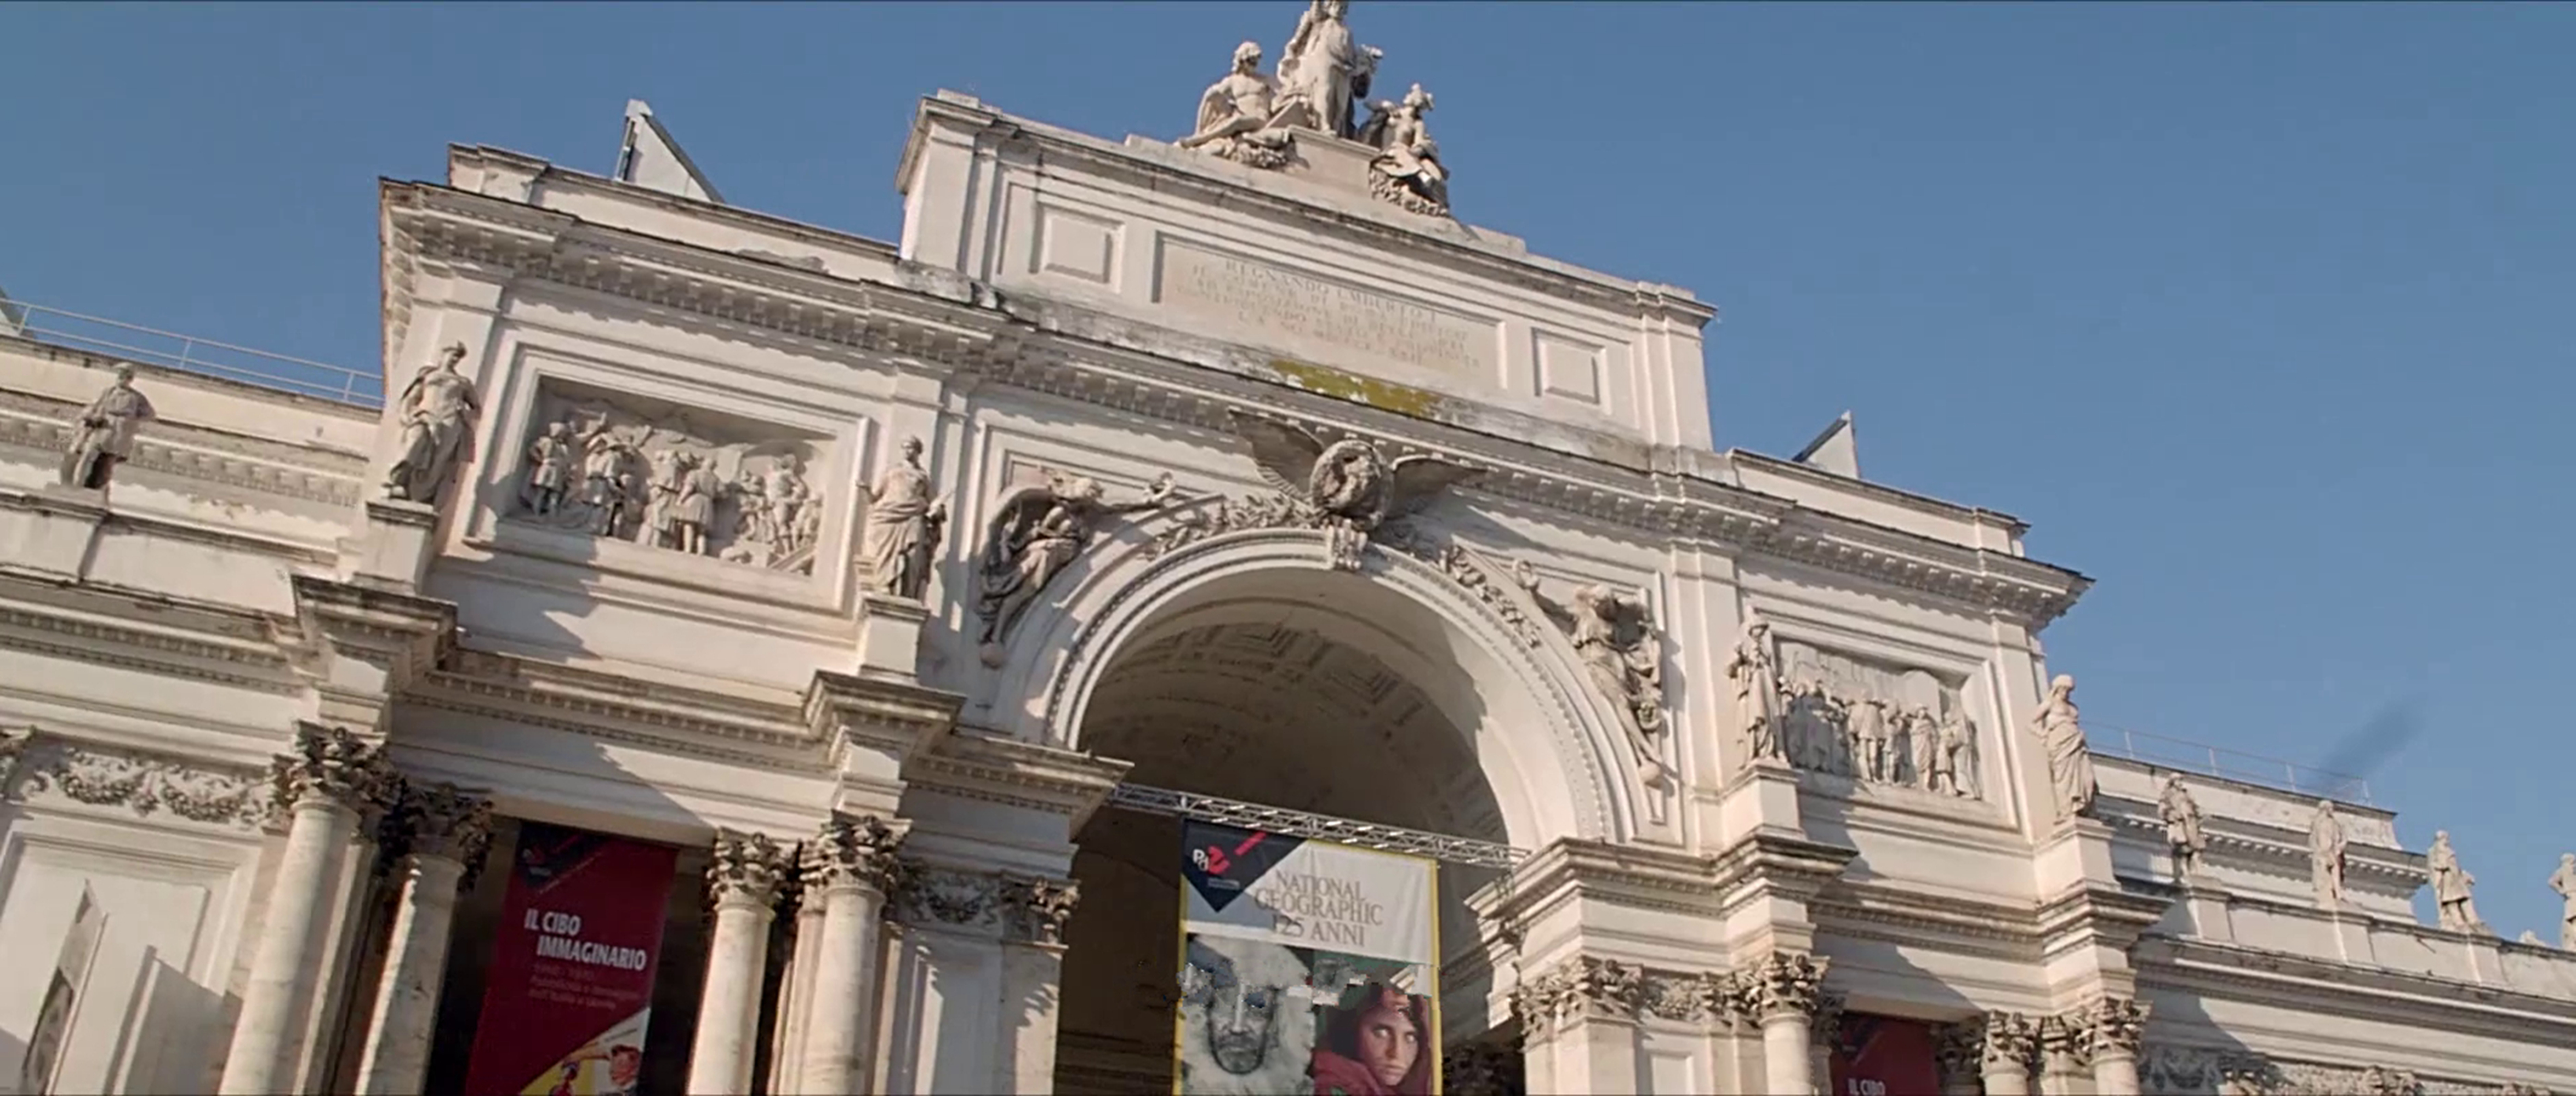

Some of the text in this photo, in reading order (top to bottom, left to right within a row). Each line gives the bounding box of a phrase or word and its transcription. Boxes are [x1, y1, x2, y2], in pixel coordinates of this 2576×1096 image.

[1276, 870, 1366, 901] NATIONAL
[525, 908, 581, 936] IL CIBO
[1255, 889, 1383, 926] GEOGRAPHIC
[1310, 921, 1365, 946] ANNI
[537, 935, 647, 971] IMMAGINARIO
